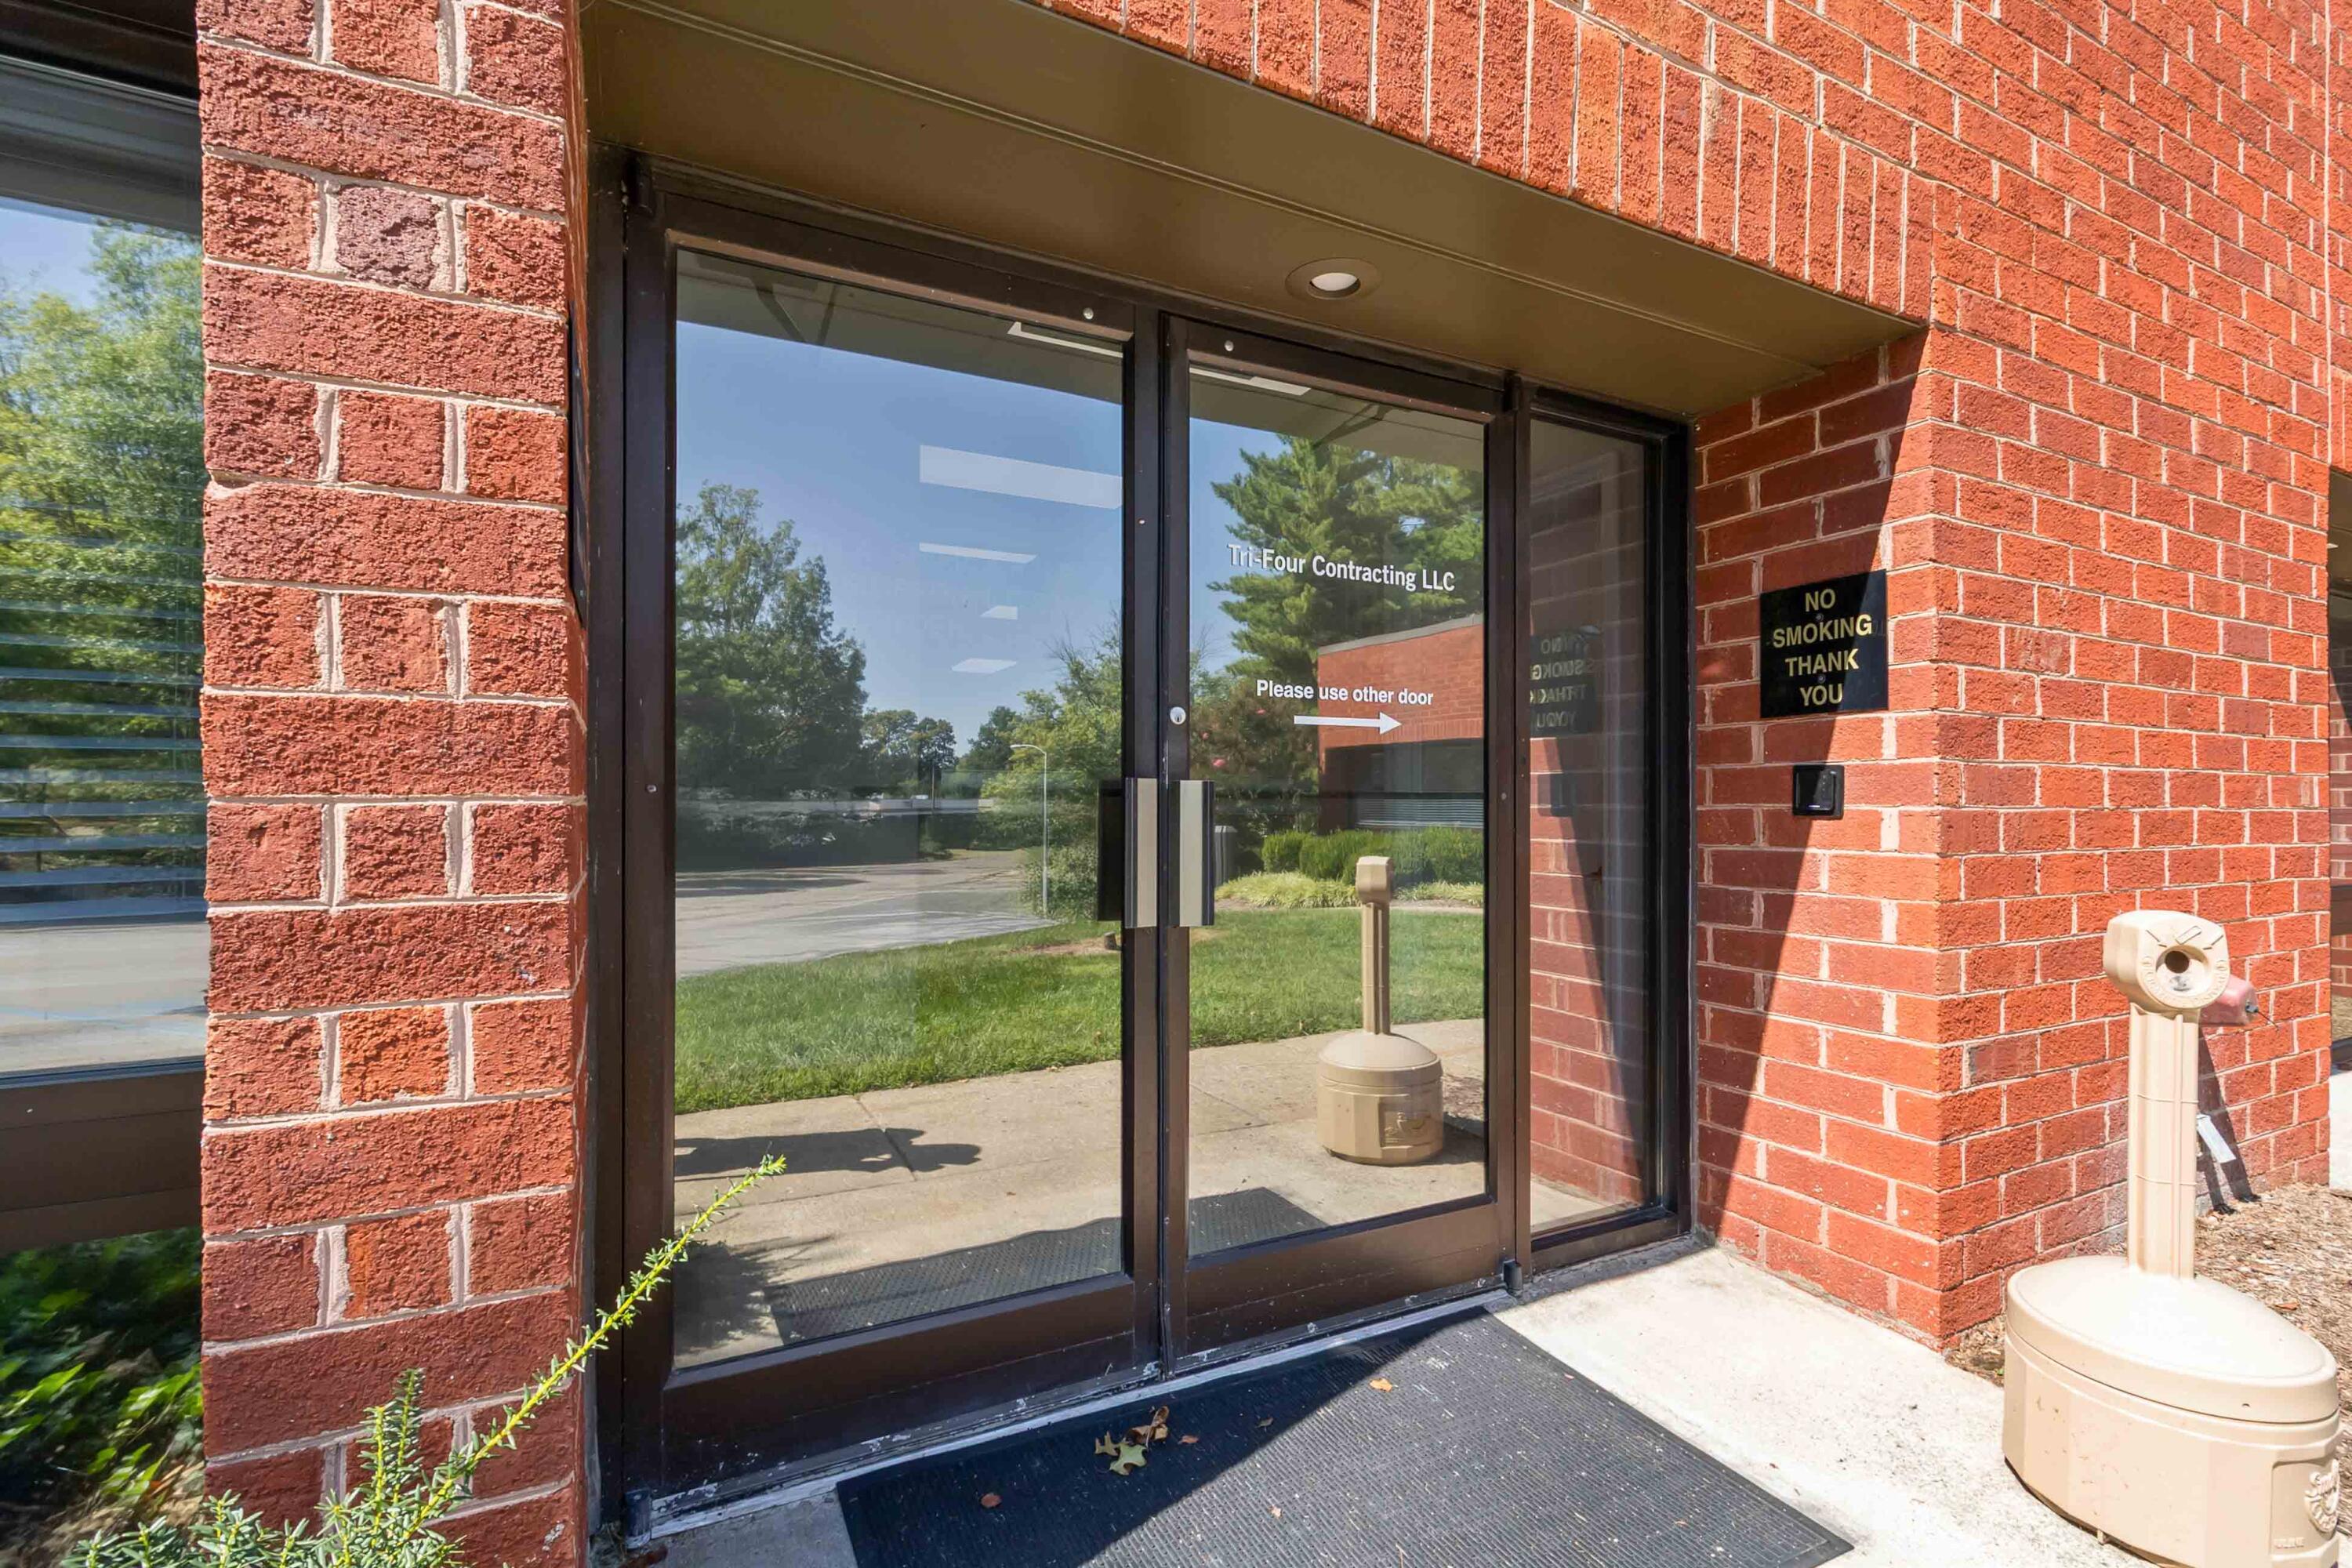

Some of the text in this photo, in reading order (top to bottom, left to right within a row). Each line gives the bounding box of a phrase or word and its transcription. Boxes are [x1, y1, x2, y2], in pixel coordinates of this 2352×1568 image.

[1228, 543, 1455, 591] Tri-Four Contracting LLC
[1805, 589, 1836, 612] NO
[1773, 614, 1872, 648] SMOKING
[1785, 648, 1859, 677] THANK
[1257, 680, 1434, 705] Please use other door
[1800, 683, 1843, 706] YOU
